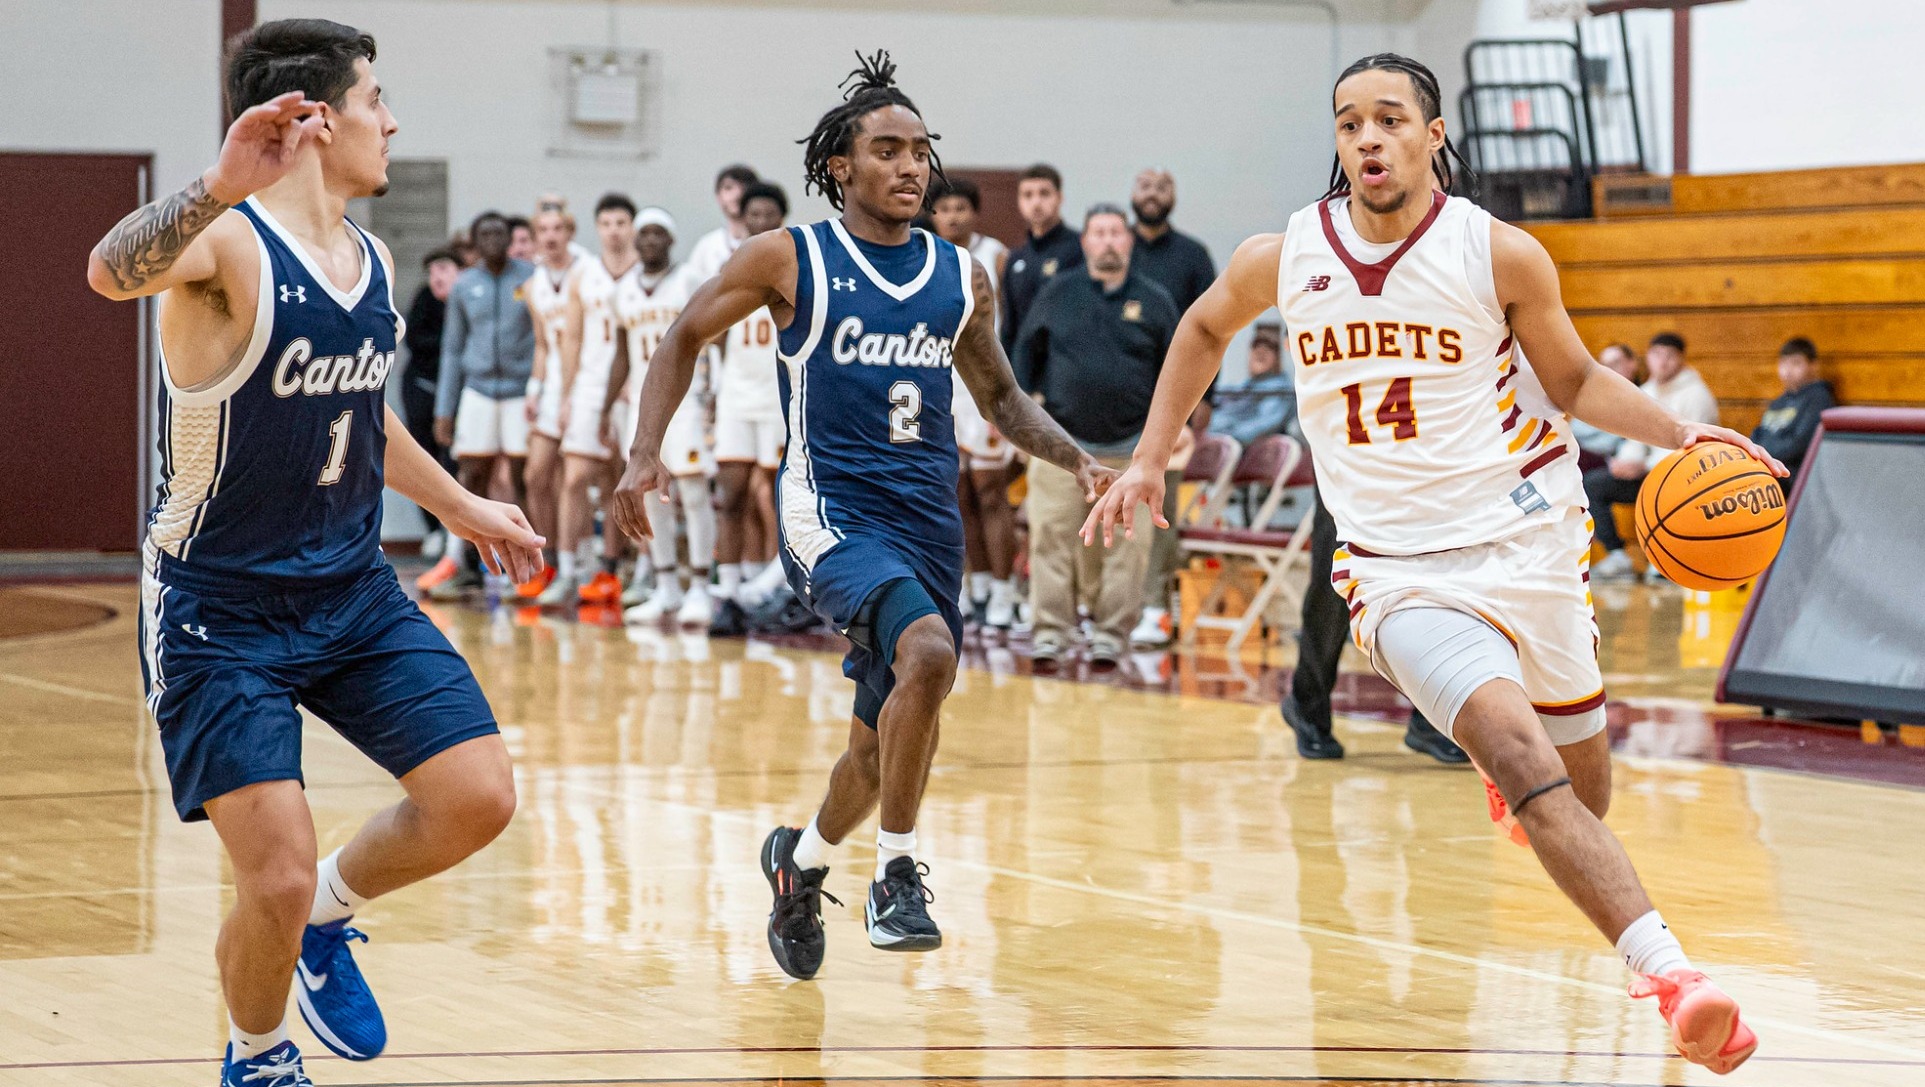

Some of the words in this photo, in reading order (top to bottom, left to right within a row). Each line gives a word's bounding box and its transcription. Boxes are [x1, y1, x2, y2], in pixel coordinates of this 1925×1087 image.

[743, 318, 771, 346] 10
[832, 315, 953, 369] Canton
[1298, 321, 1463, 367] CADETS
[888, 380, 923, 444] 2
[1341, 376, 1419, 447] 14
[317, 410, 353, 486] 1
[1699, 448, 1748, 472] EVO
[1701, 483, 1784, 521] Wilson
